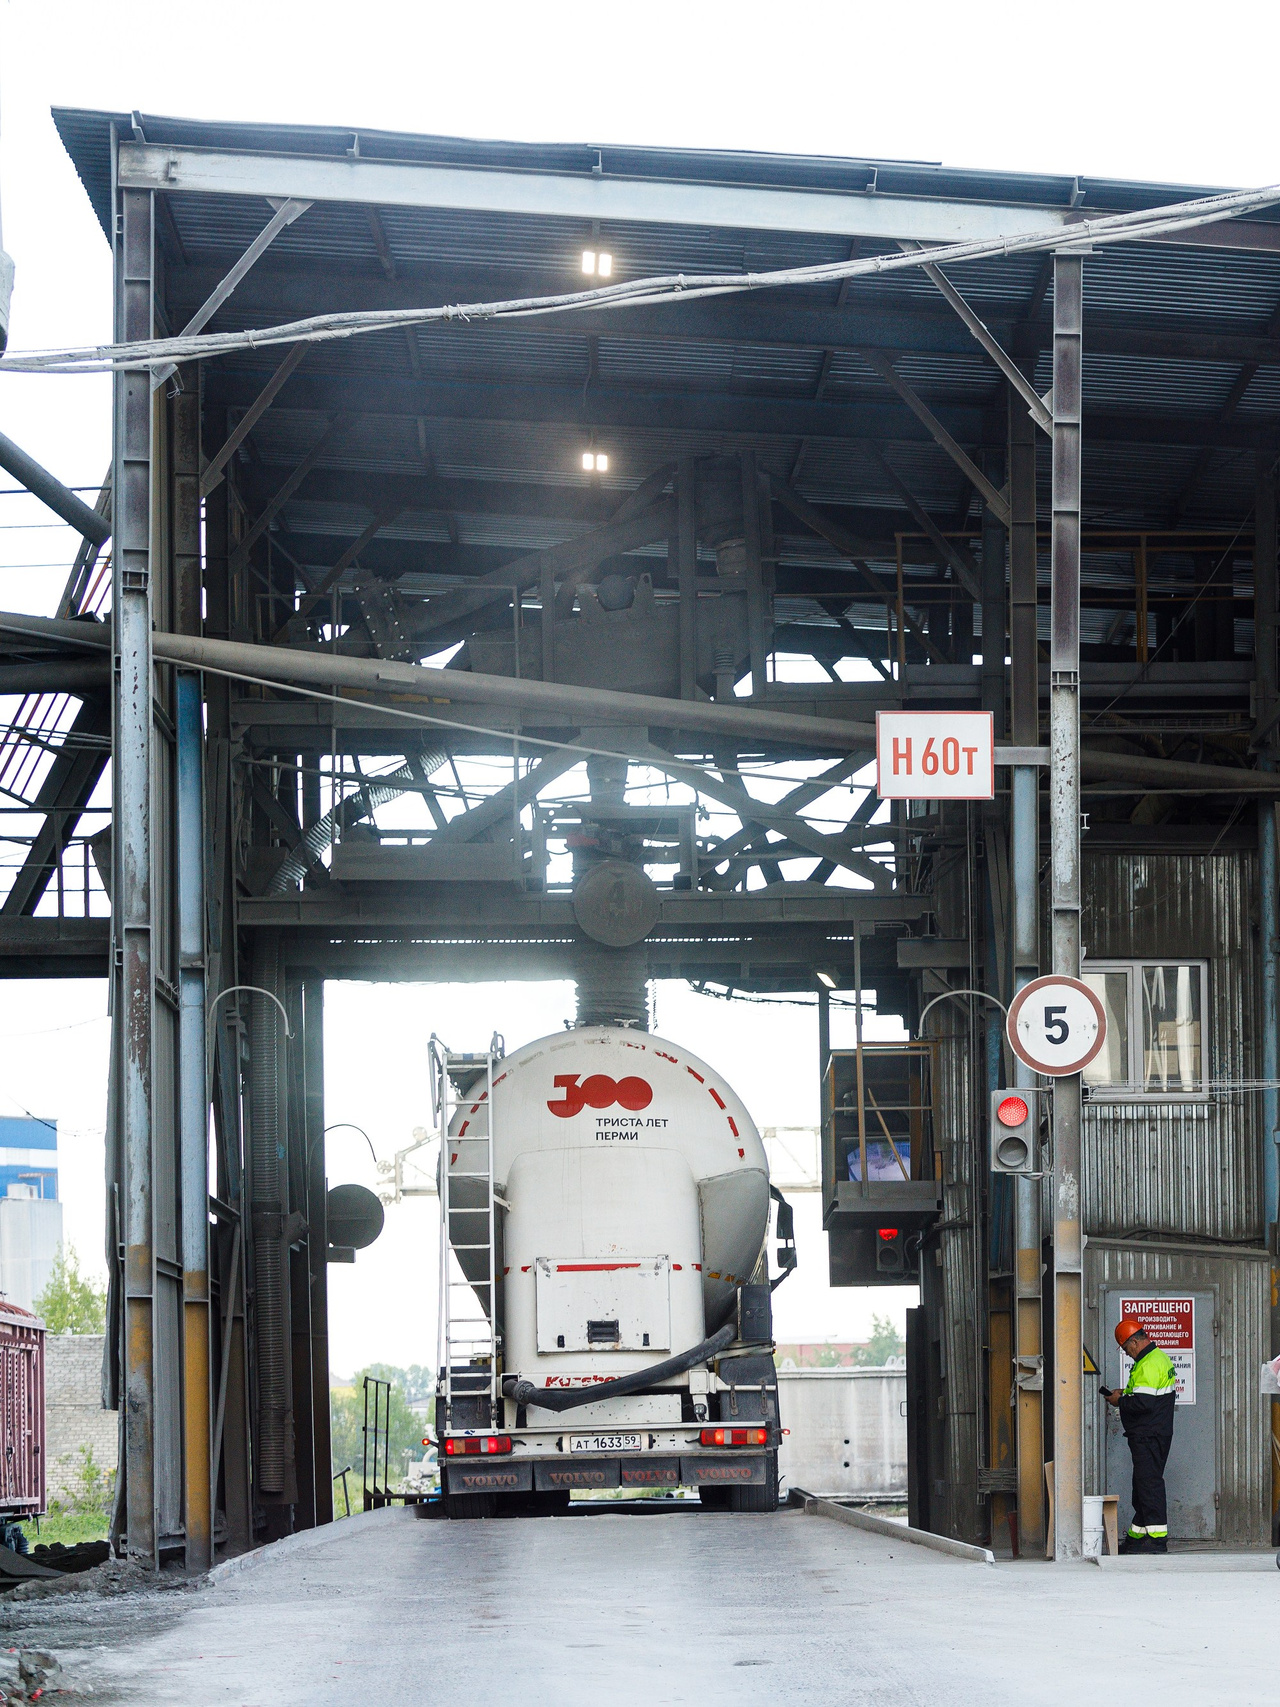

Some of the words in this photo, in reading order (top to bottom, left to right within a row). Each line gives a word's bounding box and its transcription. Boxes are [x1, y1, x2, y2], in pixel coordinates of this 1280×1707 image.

[1044, 1005, 1070, 1045] 5
[546, 1073, 654, 1119] 300
[595, 1118, 644, 1127] ТРИСТА
[645, 1118, 669, 1128] ЛЕТ
[595, 1131, 639, 1141] ПЕРМИ
[1124, 1302, 1191, 1314] ЗАПРЕЩЕНО
[1149, 1331, 1189, 1339] РАБОТАЮЩЕГО
[593, 1437, 622, 1449] 1633
[624, 1435, 636, 1445] 59
[462, 1474, 519, 1487] VOLVO
[550, 1472, 605, 1484] VOLVO
[622, 1469, 677, 1482] VOLVO
[696, 1468, 752, 1480] VOLVO
